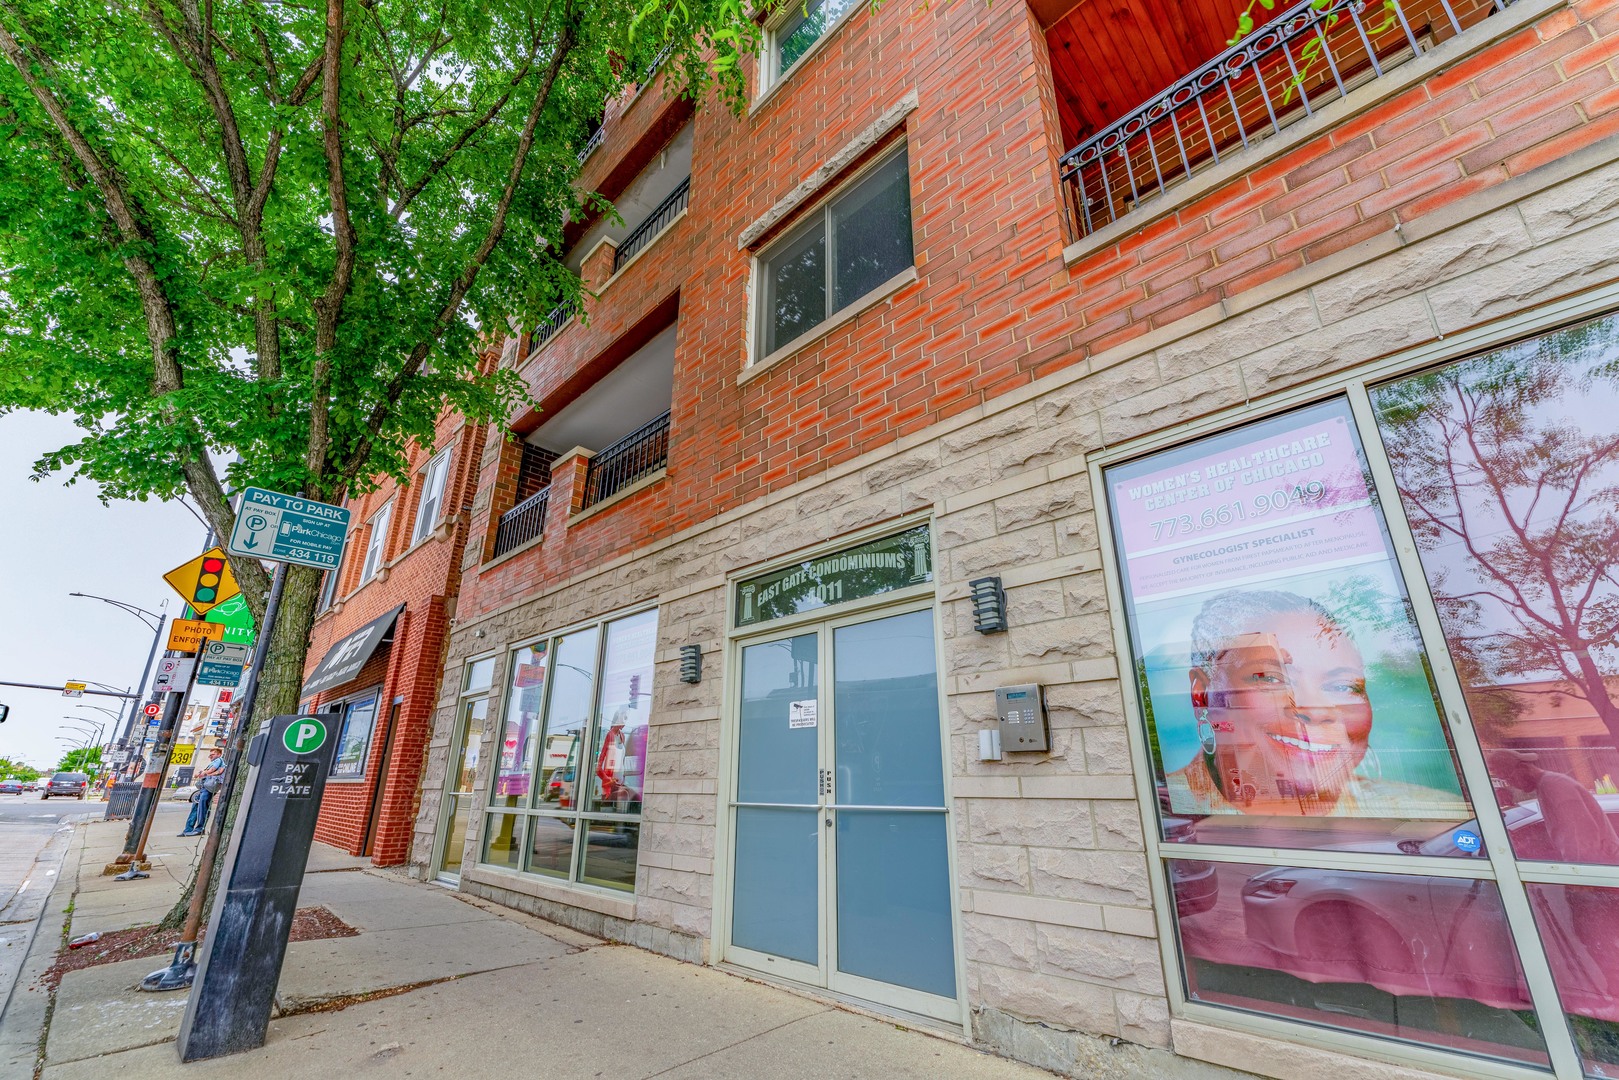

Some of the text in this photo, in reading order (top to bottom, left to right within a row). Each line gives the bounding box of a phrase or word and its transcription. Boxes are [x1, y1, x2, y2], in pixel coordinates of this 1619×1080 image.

[1129, 432, 1331, 500] WOMEN'S HEALTHCARE
[1145, 452, 1324, 511] CENTER OF CHICAGO
[252, 492, 344, 520] PAY TO PARK
[1150, 480, 1326, 540] 773.661.9049
[1173, 528, 1314, 564] GYNECOLOGIST SPECIALIST
[289, 549, 334, 563] 434 119
[758, 552, 906, 607] EAST GATE CONDOMINIUMS
[184, 626, 212, 634] PHOTO
[224, 627, 254, 637] NITY
[173, 636, 201, 644] ENFOR
[296, 724, 317, 748] P
[285, 764, 310, 772] PAY
[284, 775, 302, 784] BY
[270, 786, 311, 794] PLATE
[1457, 836, 1476, 844] ADT
